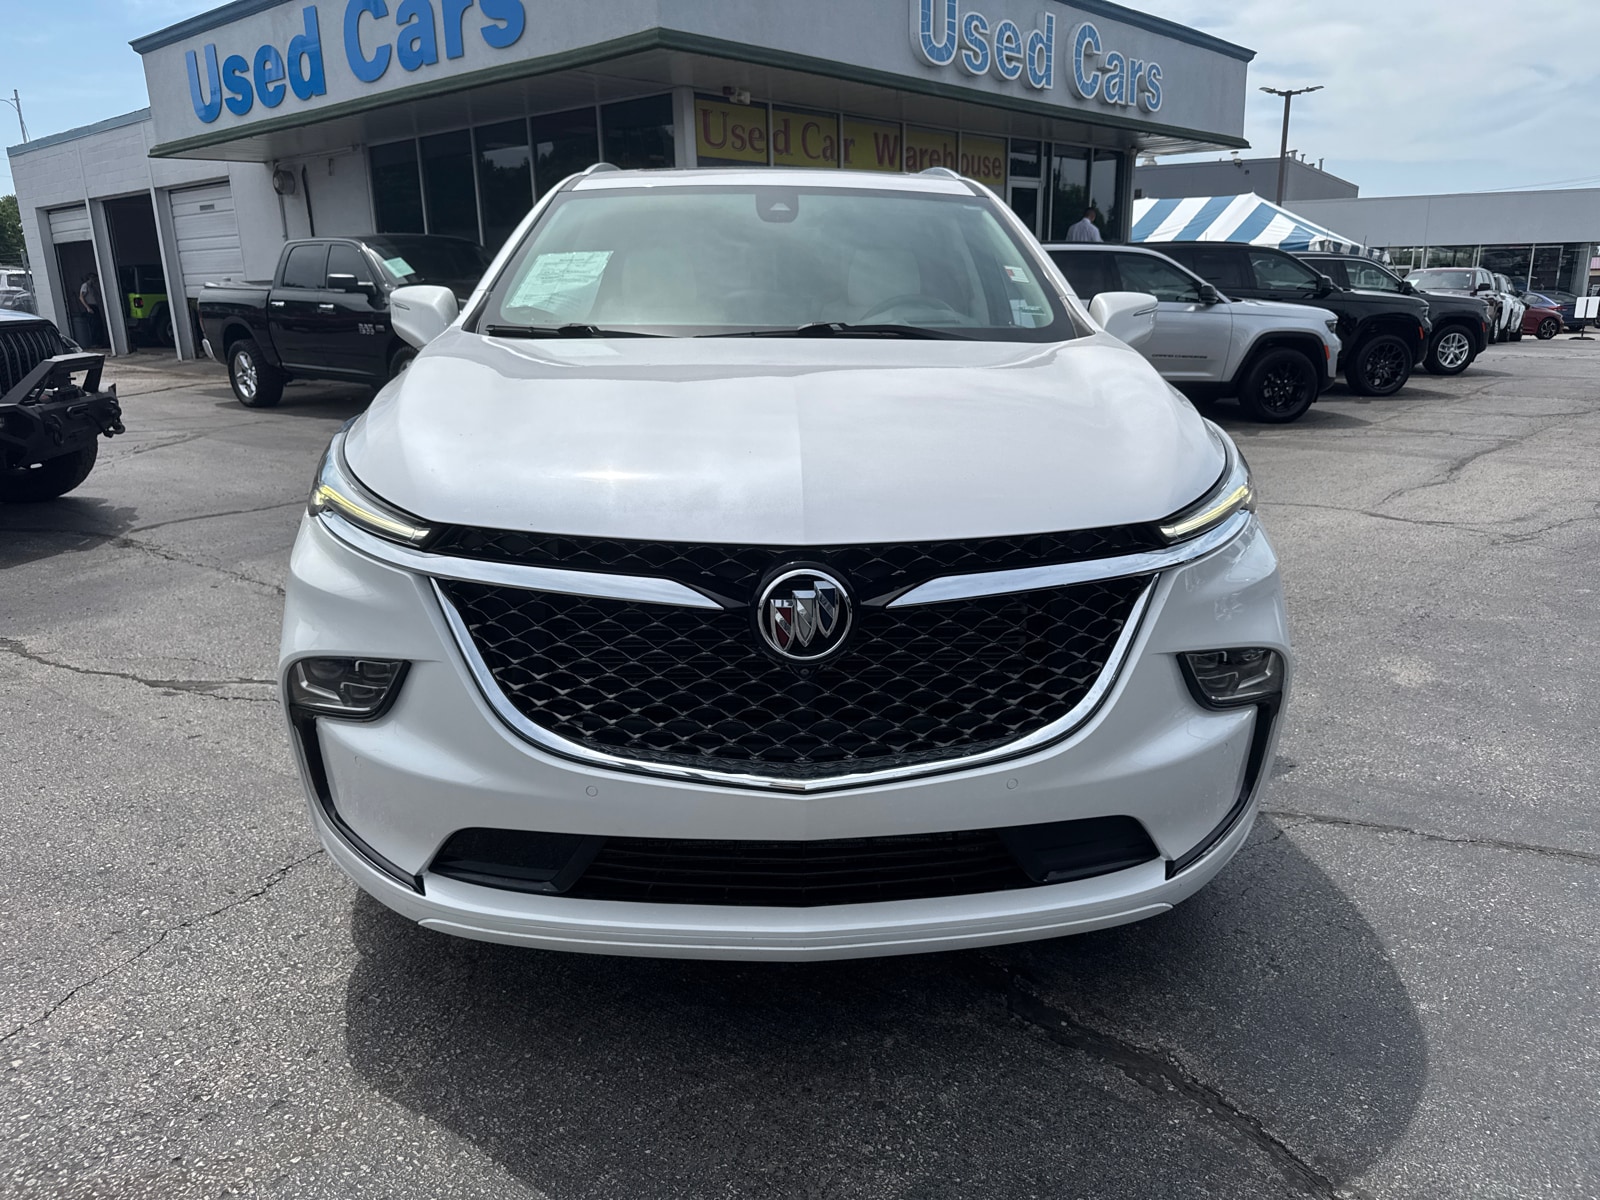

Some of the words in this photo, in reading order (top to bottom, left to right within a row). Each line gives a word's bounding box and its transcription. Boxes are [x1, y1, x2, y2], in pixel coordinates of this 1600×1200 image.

[185, 5, 327, 124] Used
[343, 0, 526, 83] Cars
[911, 0, 1056, 89] Used
[1068, 21, 1163, 113] Cars
[700, 109, 793, 156] Used
[801, 121, 856, 164] Car
[873, 132, 1003, 180] Warehouse
